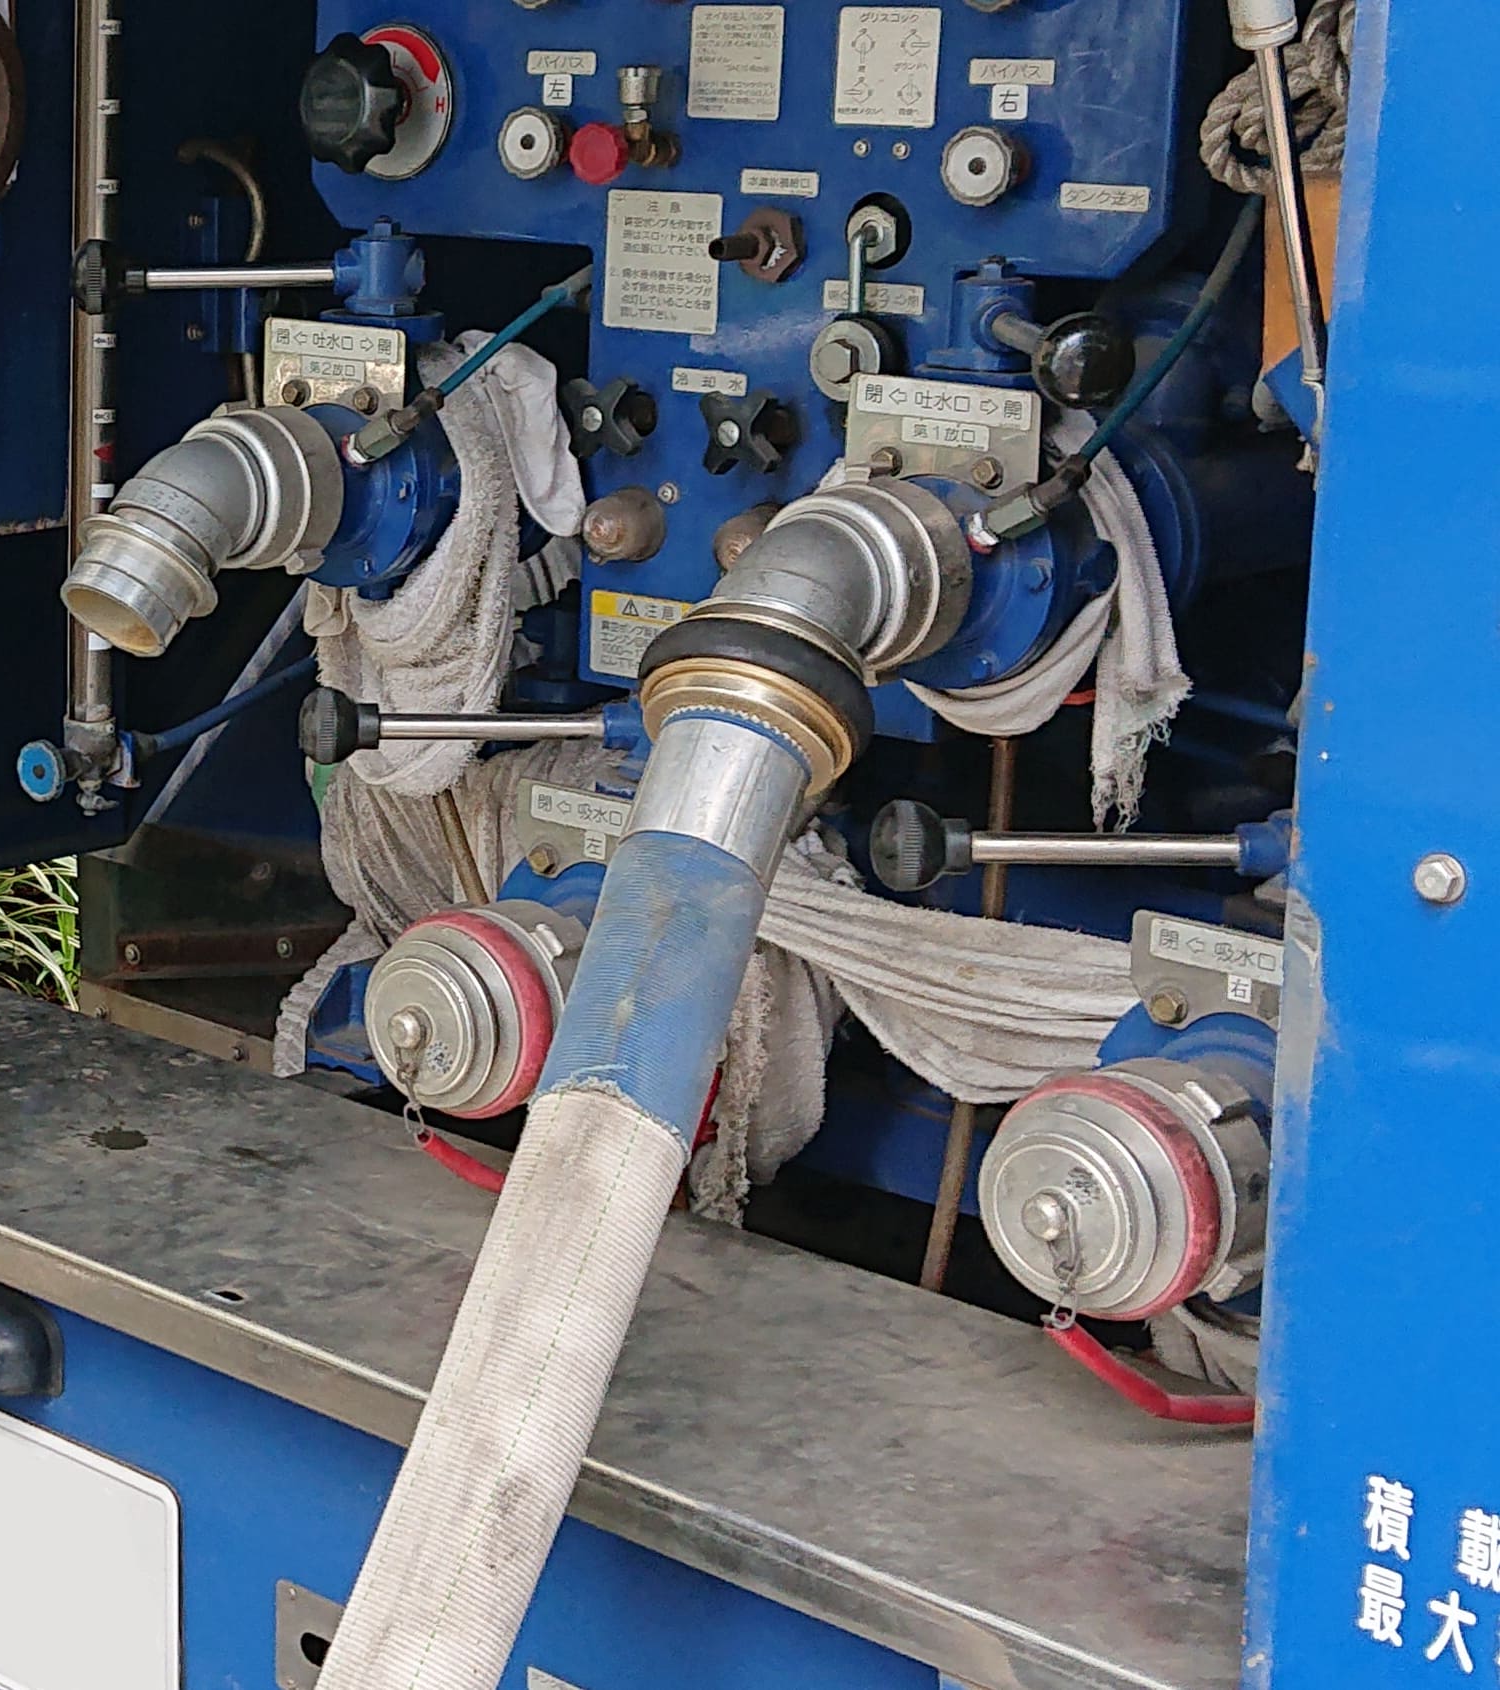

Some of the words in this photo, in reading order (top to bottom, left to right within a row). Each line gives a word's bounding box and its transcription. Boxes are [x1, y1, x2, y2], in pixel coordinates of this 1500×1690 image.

[860, 12, 919, 23] グリスコック
[536, 56, 585, 69] バイパス
[980, 64, 1042, 79] バイパス
[548, 79, 567, 100] 左
[435, 95, 446, 113] H
[999, 89, 1019, 113] 右
[1064, 188, 1147, 207] タンク送水
[276, 327, 290, 345] 閉
[312, 331, 354, 351] 吐水口
[377, 337, 393, 356] 開
[309, 360, 356, 378] 第2放口
[675, 371, 743, 392] 冷却水
[865, 383, 883, 404] 閉
[914, 388, 971, 413] 吐水口
[1003, 399, 1023, 421] 開
[913, 423, 976, 444] 第1放口
[538, 793, 552, 812] 閉
[577, 803, 623, 827] 吸水口
[585, 838, 603, 856] 左
[1158, 927, 1180, 951] 閉
[1213, 941, 1277, 972] 吸水口
[1230, 978, 1250, 999] 右
[1358, 1562, 1500, 1675] 最大
